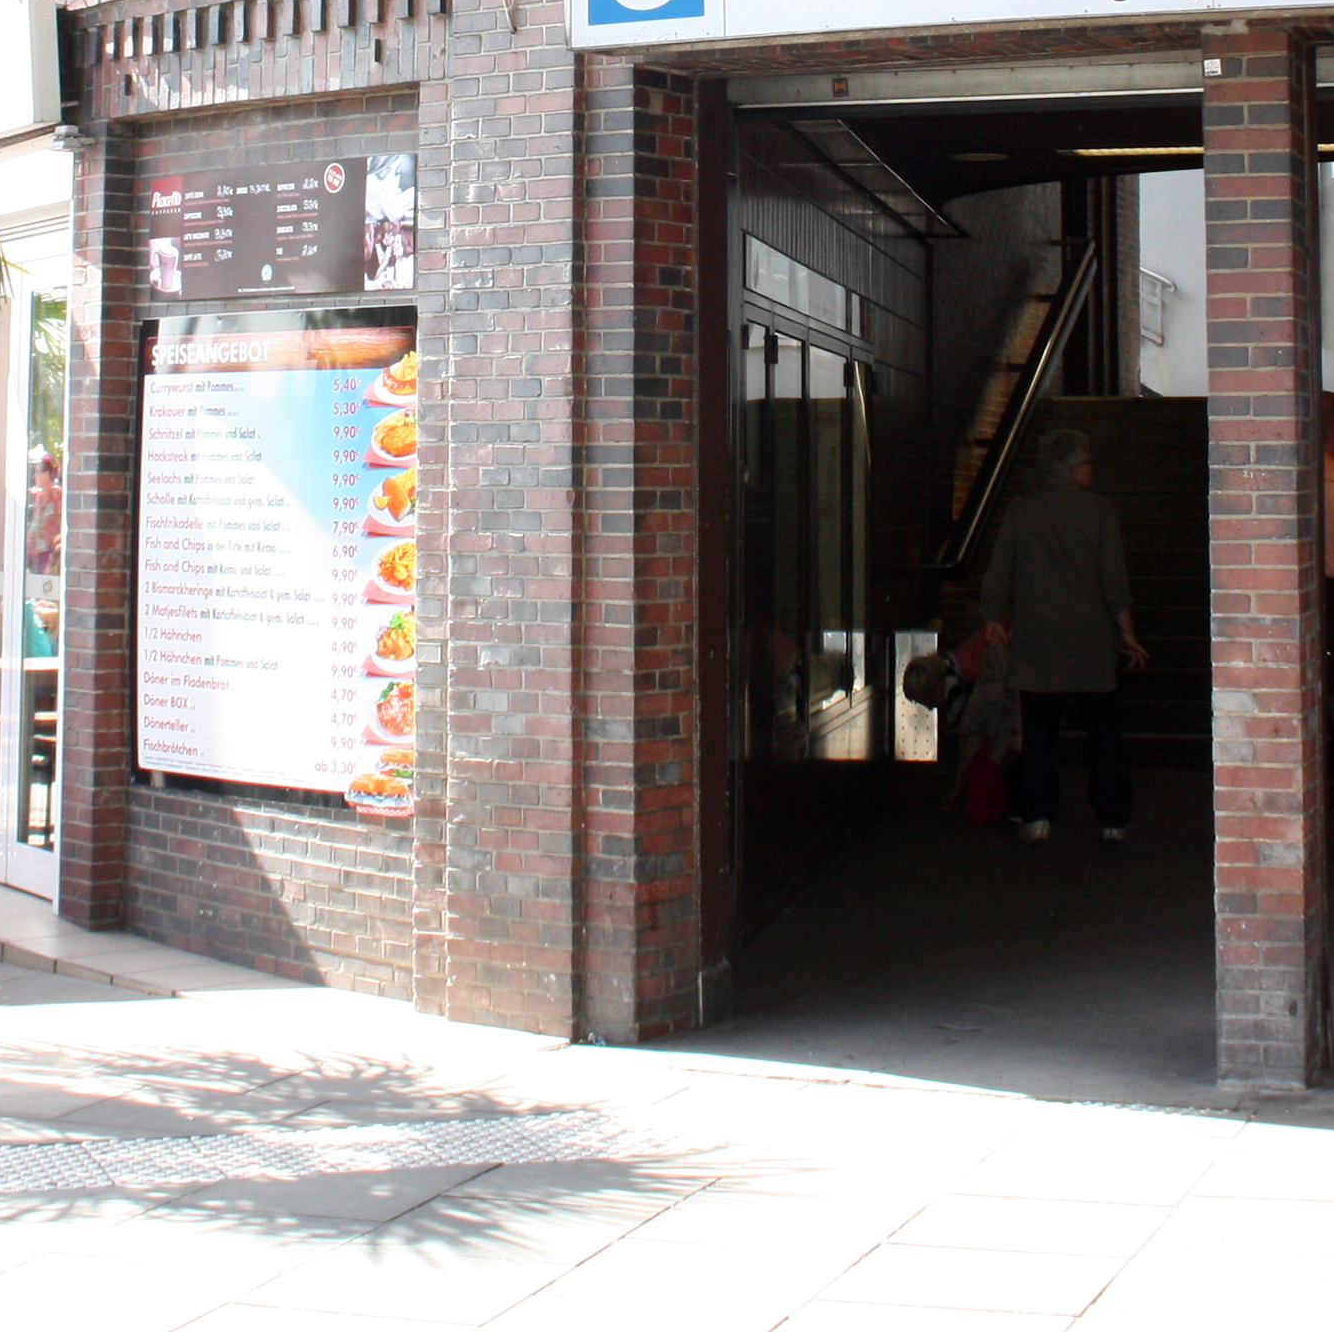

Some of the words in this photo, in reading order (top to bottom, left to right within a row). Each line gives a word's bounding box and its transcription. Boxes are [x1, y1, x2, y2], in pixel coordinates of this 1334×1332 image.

[152, 341, 271, 366] SPEISEANGEBOT
[150, 382, 193, 395] Currywurst
[207, 380, 234, 392] Pommes
[149, 406, 185, 416] Krakauer
[199, 405, 225, 416] Pommes
[149, 428, 183, 440] Schnitzel
[239, 428, 256, 438] Salat
[148, 451, 188, 462] Hacksteak
[245, 451, 262, 462] Salat
[147, 473, 182, 484] Seelachs
[147, 493, 175, 505] Scholle
[146, 516, 203, 530] Fischfrikadelle
[145, 537, 161, 549] Fish
[164, 538, 179, 550] and
[182, 538, 205, 552] Chips
[144, 559, 160, 572] Fish
[163, 560, 179, 572] and
[181, 561, 205, 575] Chips
[144, 581, 149, 593] 2
[152, 581, 213, 599] Bismarckheringe
[144, 604, 149, 616] 2
[144, 626, 157, 640] 1/2
[160, 627, 202, 642] Hähnchen
[144, 649, 157, 662] 1/2
[160, 650, 201, 665] Hähnchen
[144, 671, 169, 685] Döner
[171, 674, 180, 687] im
[183, 675, 229, 690] Fladenbrot
[144, 693, 168, 707] Döner
[170, 696, 189, 710] BOX
[144, 716, 189, 732] Dönerteller
[144, 738, 198, 756] Fischbrötchen
